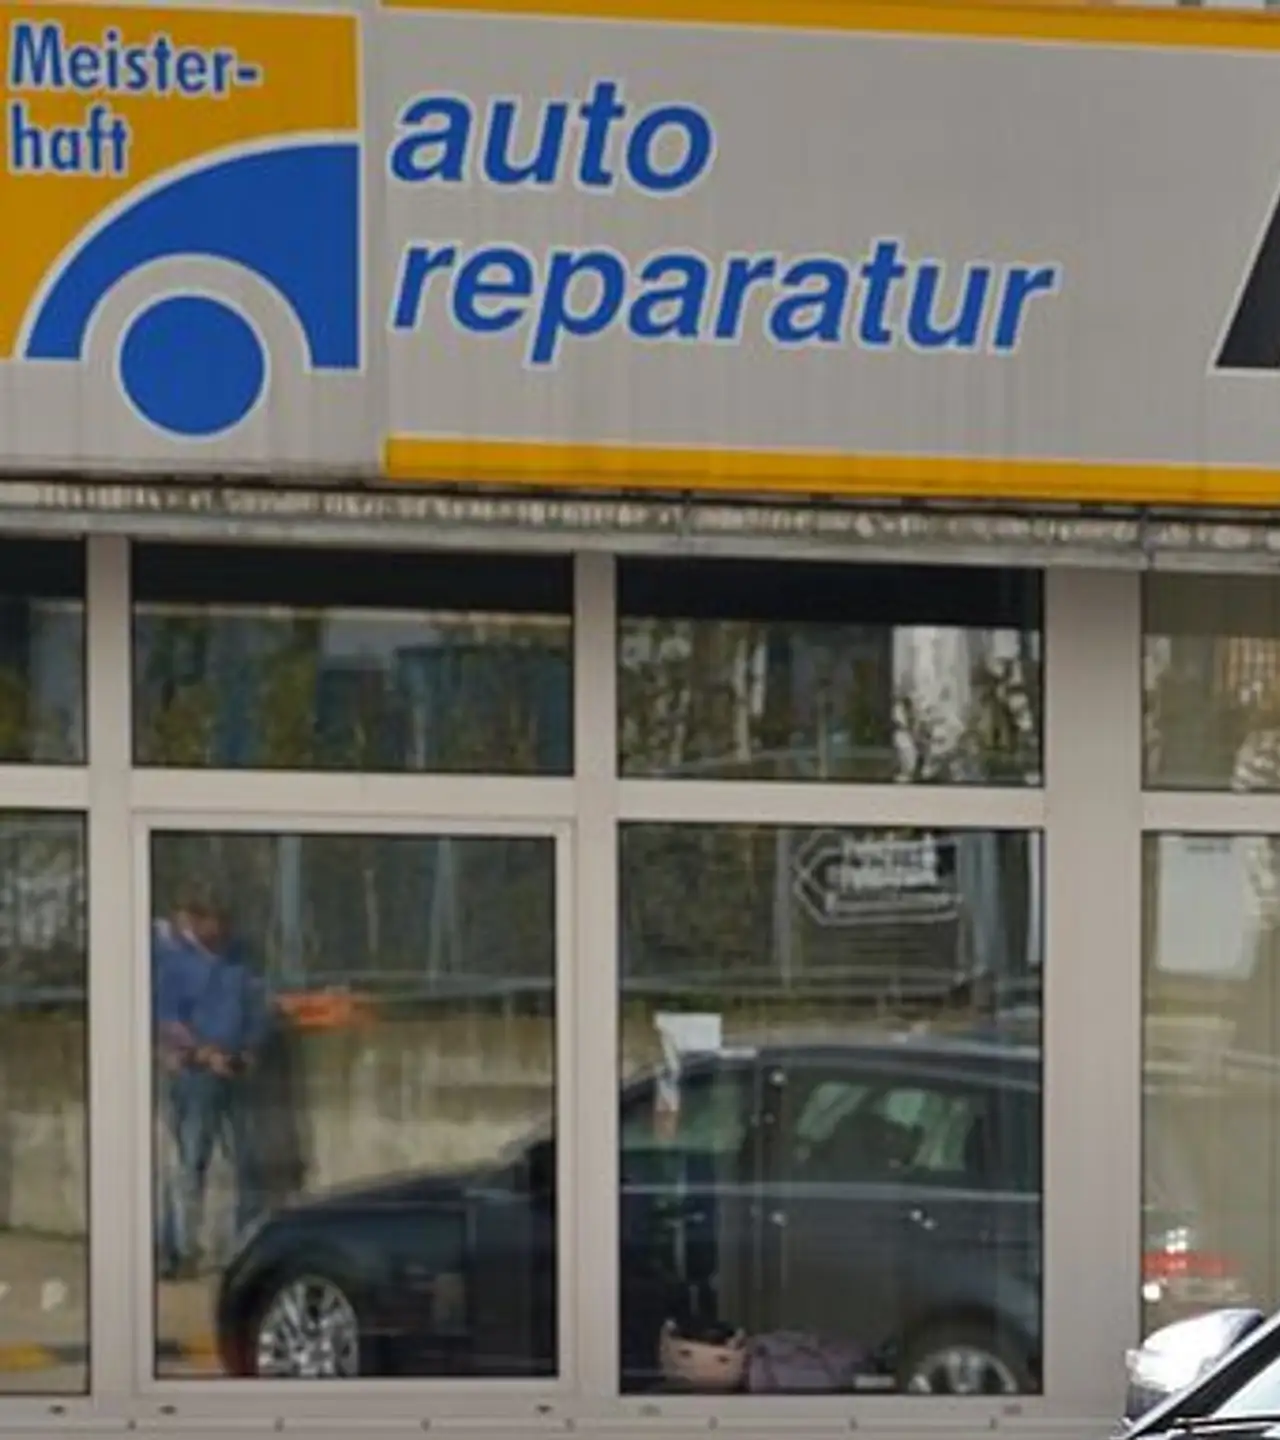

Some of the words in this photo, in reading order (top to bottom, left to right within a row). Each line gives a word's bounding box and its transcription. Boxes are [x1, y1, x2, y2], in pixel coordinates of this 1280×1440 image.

[11, 24, 259, 93] Meister-
[11, 106, 128, 172] haft
[388, 79, 715, 194] auto
[391, 240, 1056, 365] reparatur
